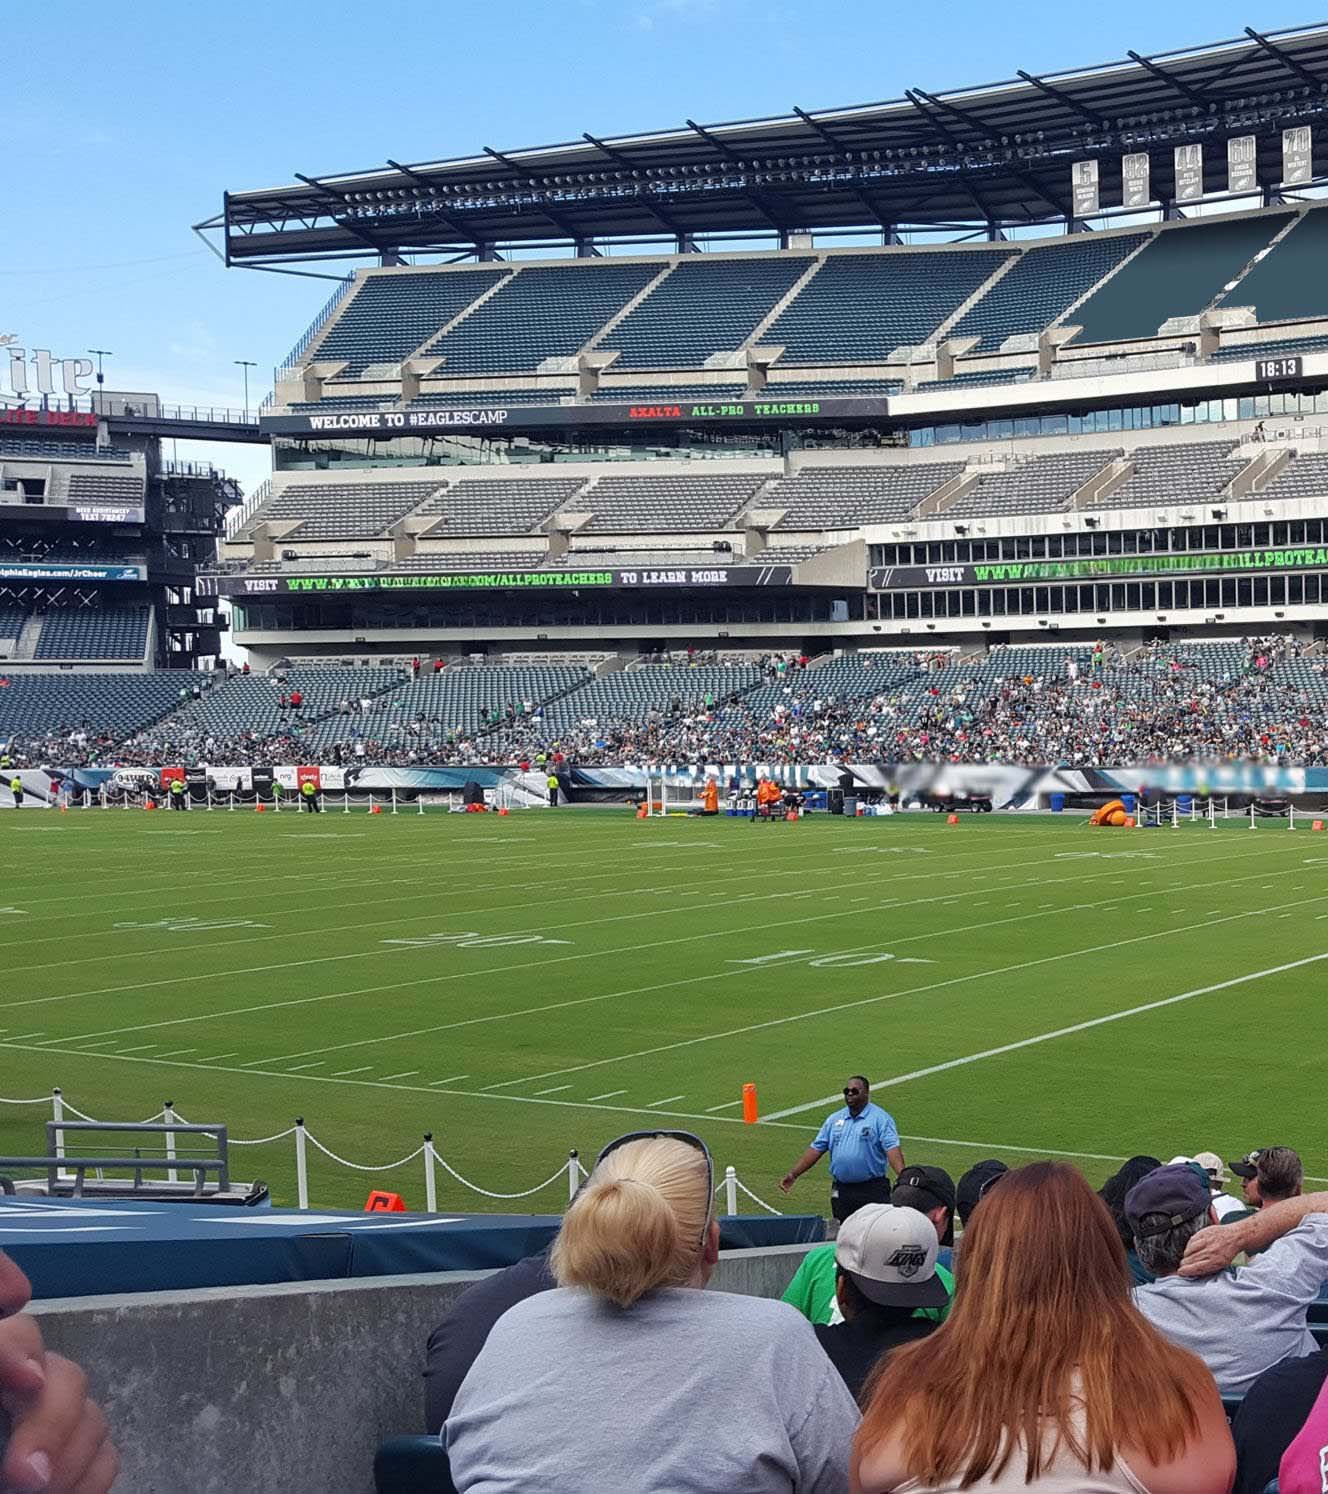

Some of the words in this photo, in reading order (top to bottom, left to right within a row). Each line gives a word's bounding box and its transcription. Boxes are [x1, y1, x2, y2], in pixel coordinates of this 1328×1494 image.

[1232, 137, 1253, 163] 60
[1284, 128, 1309, 153] 70
[1125, 155, 1146, 179] 92
[1177, 146, 1200, 171] 44
[1080, 163, 1091, 185] 5
[0, 347, 93, 398] ite
[1261, 360, 1296, 377] 18:13
[310, 414, 380, 429] WELCOME
[387, 413, 404, 427] TO
[409, 410, 508, 426] #EAGLESCAMP
[629, 407, 681, 417] AXALTA
[692, 405, 744, 416] ALL-PRO
[755, 403, 820, 414] TEACHERS
[244, 580, 278, 591] VISIT
[621, 572, 637, 583] TO
[643, 571, 686, 583] LEARN
[692, 570, 727, 583] MORE
[925, 568, 964, 582] VISIT
[379, 931, 544, 948] 20
[724, 949, 896, 967] 10
[889, 1252, 928, 1267] KINGS
